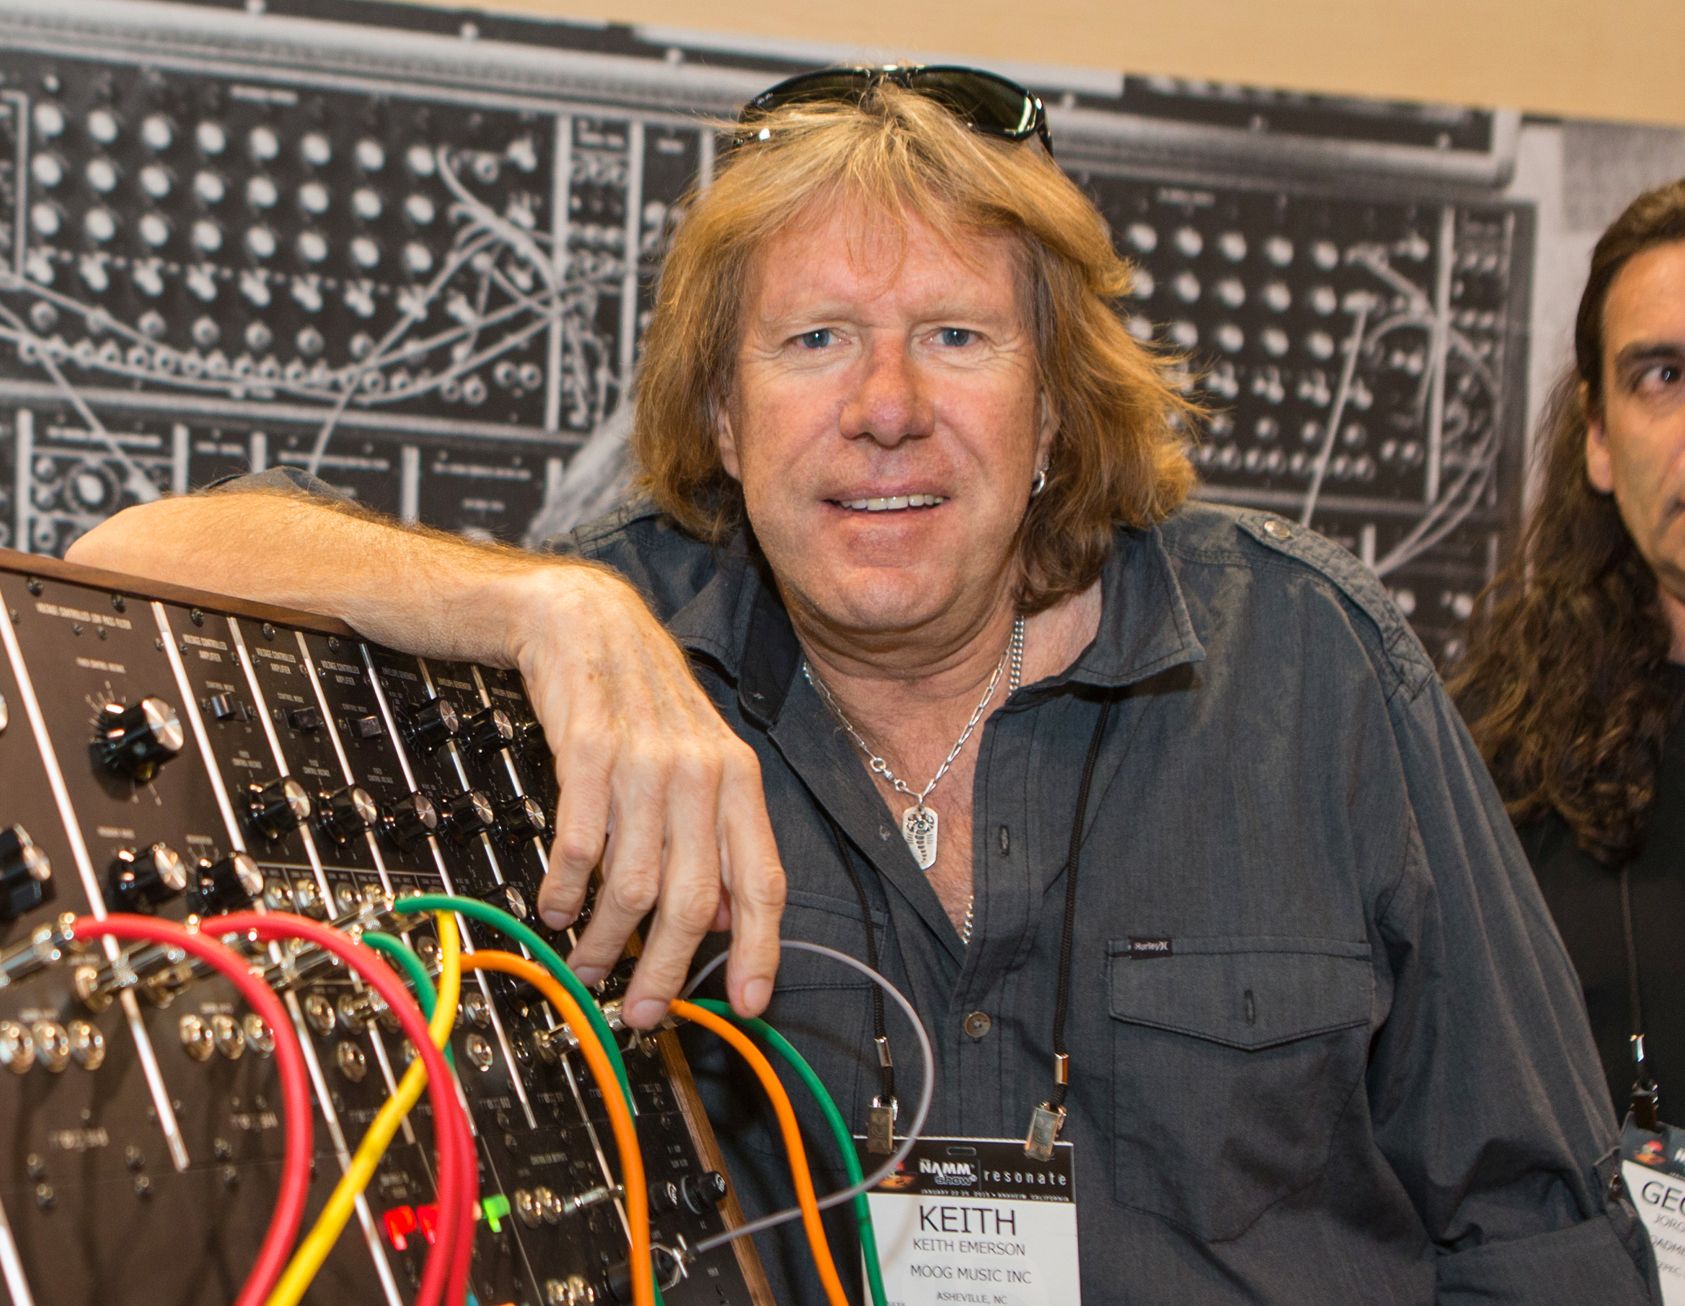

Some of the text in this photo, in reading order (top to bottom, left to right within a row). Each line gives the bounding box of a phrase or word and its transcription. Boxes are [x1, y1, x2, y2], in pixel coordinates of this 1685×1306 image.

[919, 1158, 972, 1178] NAMM
[983, 1170, 1067, 1186] resonate
[919, 1205, 1016, 1236] KEITH
[912, 1238, 1026, 1257] KEITH EMERSON
[910, 1264, 1032, 1284] MOOG MUSIC INC
[936, 1290, 1008, 1305] ASHEVILLE, NC
